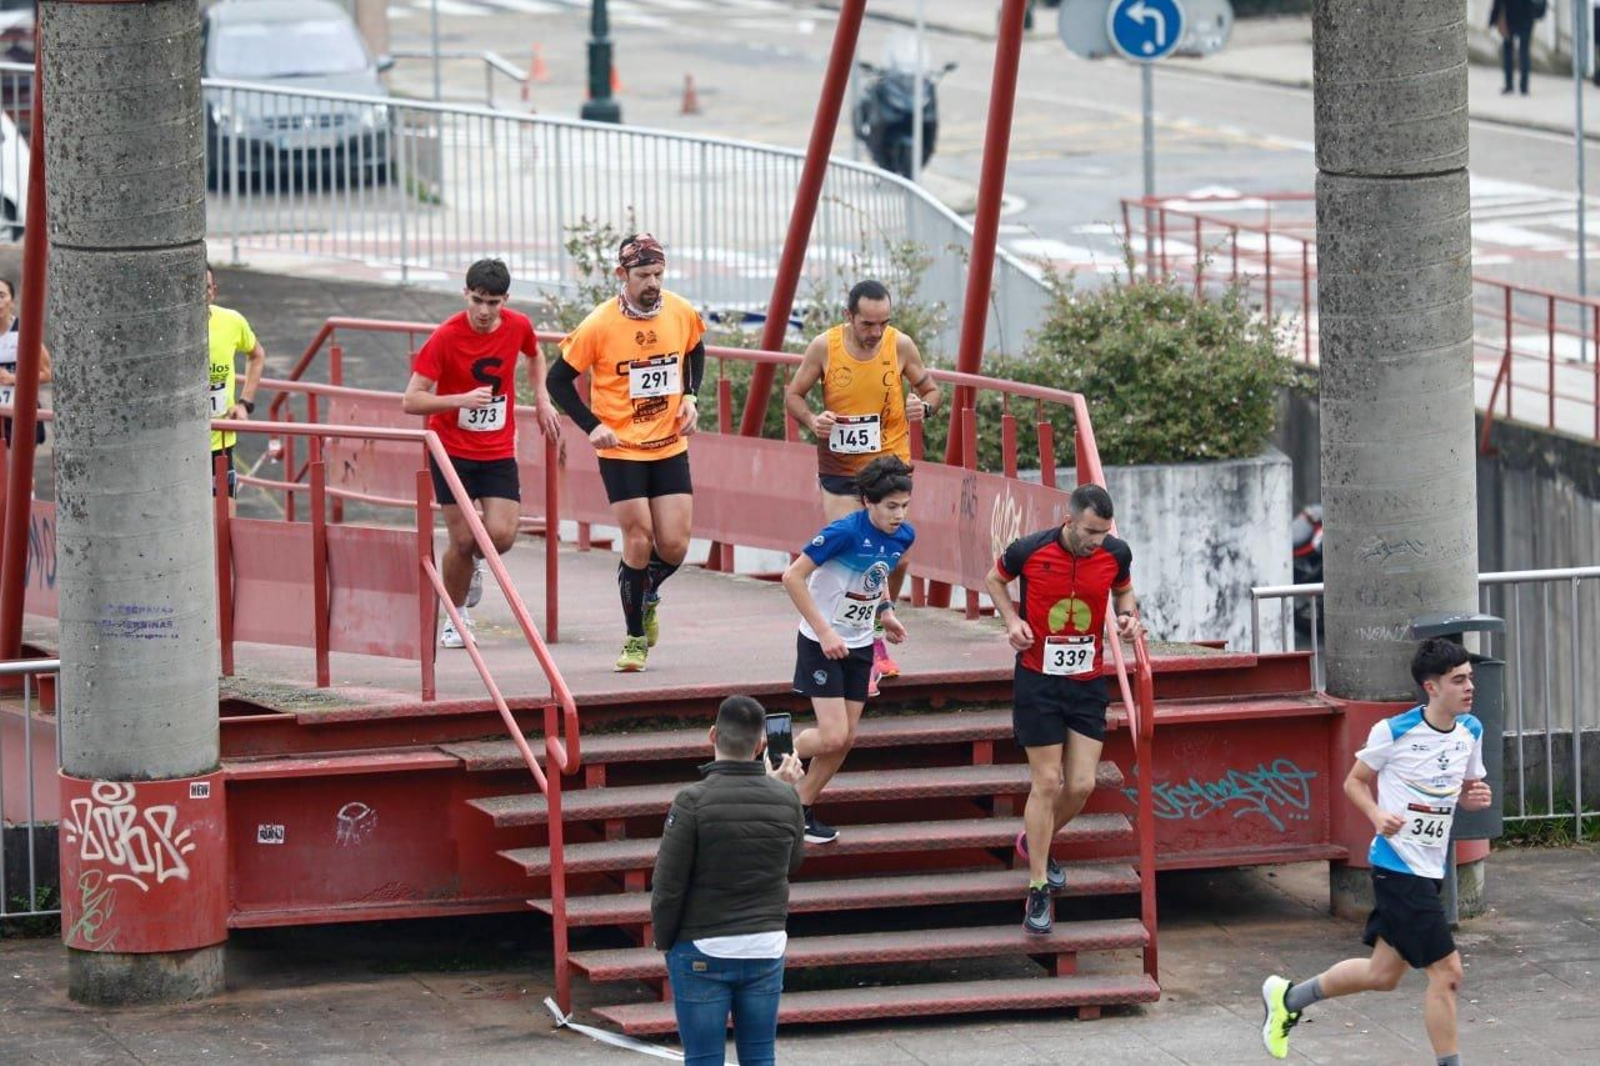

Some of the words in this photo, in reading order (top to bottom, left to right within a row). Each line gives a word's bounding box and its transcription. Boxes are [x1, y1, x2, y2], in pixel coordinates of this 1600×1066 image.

[641, 370, 669, 389] 291
[468, 408, 497, 424] 373
[838, 429, 869, 446] 145
[844, 604, 874, 621] 298
[1054, 650, 1087, 667] 339
[1411, 818, 1444, 838] 346
